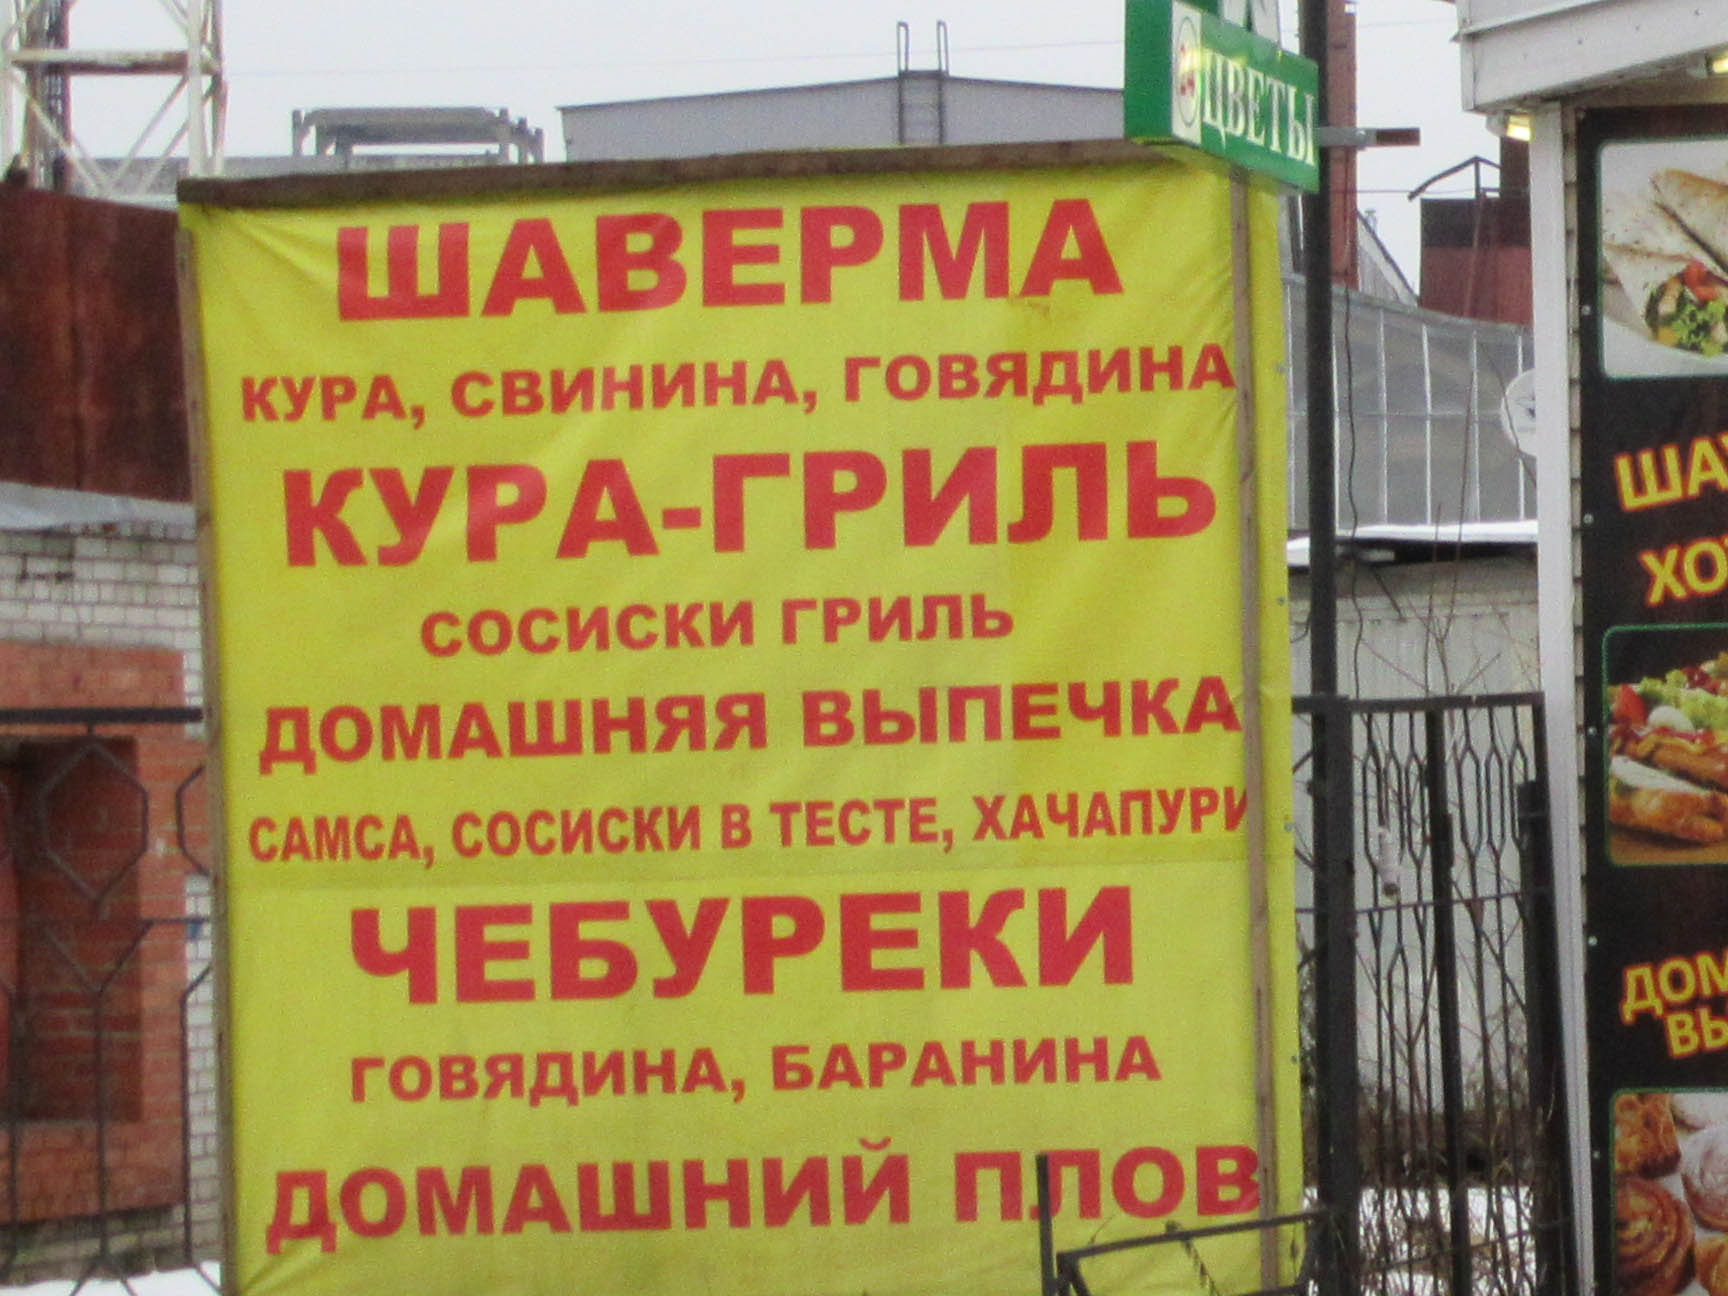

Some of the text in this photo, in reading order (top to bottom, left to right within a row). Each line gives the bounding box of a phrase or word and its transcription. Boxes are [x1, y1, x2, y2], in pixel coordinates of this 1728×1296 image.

[1203, 47, 1315, 167] ЦВЕТЫ
[338, 199, 1125, 322] ШАВЕРМА
[242, 343, 1237, 428] КУРА, СВИНИНА, ГОВЯДИНА
[283, 440, 1219, 567] КУРА-ГРИЛЬ
[422, 593, 1015, 658] СОСИСКИ ГРИЛЬ
[259, 676, 1242, 775] ДОМАШНЯЯ ВЫПЕЧКА
[247, 786, 1248, 868] САМСА, СОСИСКИ В ТЕСТЕ, ХАЧАПУРИ
[351, 886, 1134, 1004] ЧЕБУРЕКИ
[352, 1035, 1162, 1108] ГОВЯДИНА, БАРАНИНА
[266, 1138, 1262, 1254] ДОМАШНИЙ ПЛОВ
